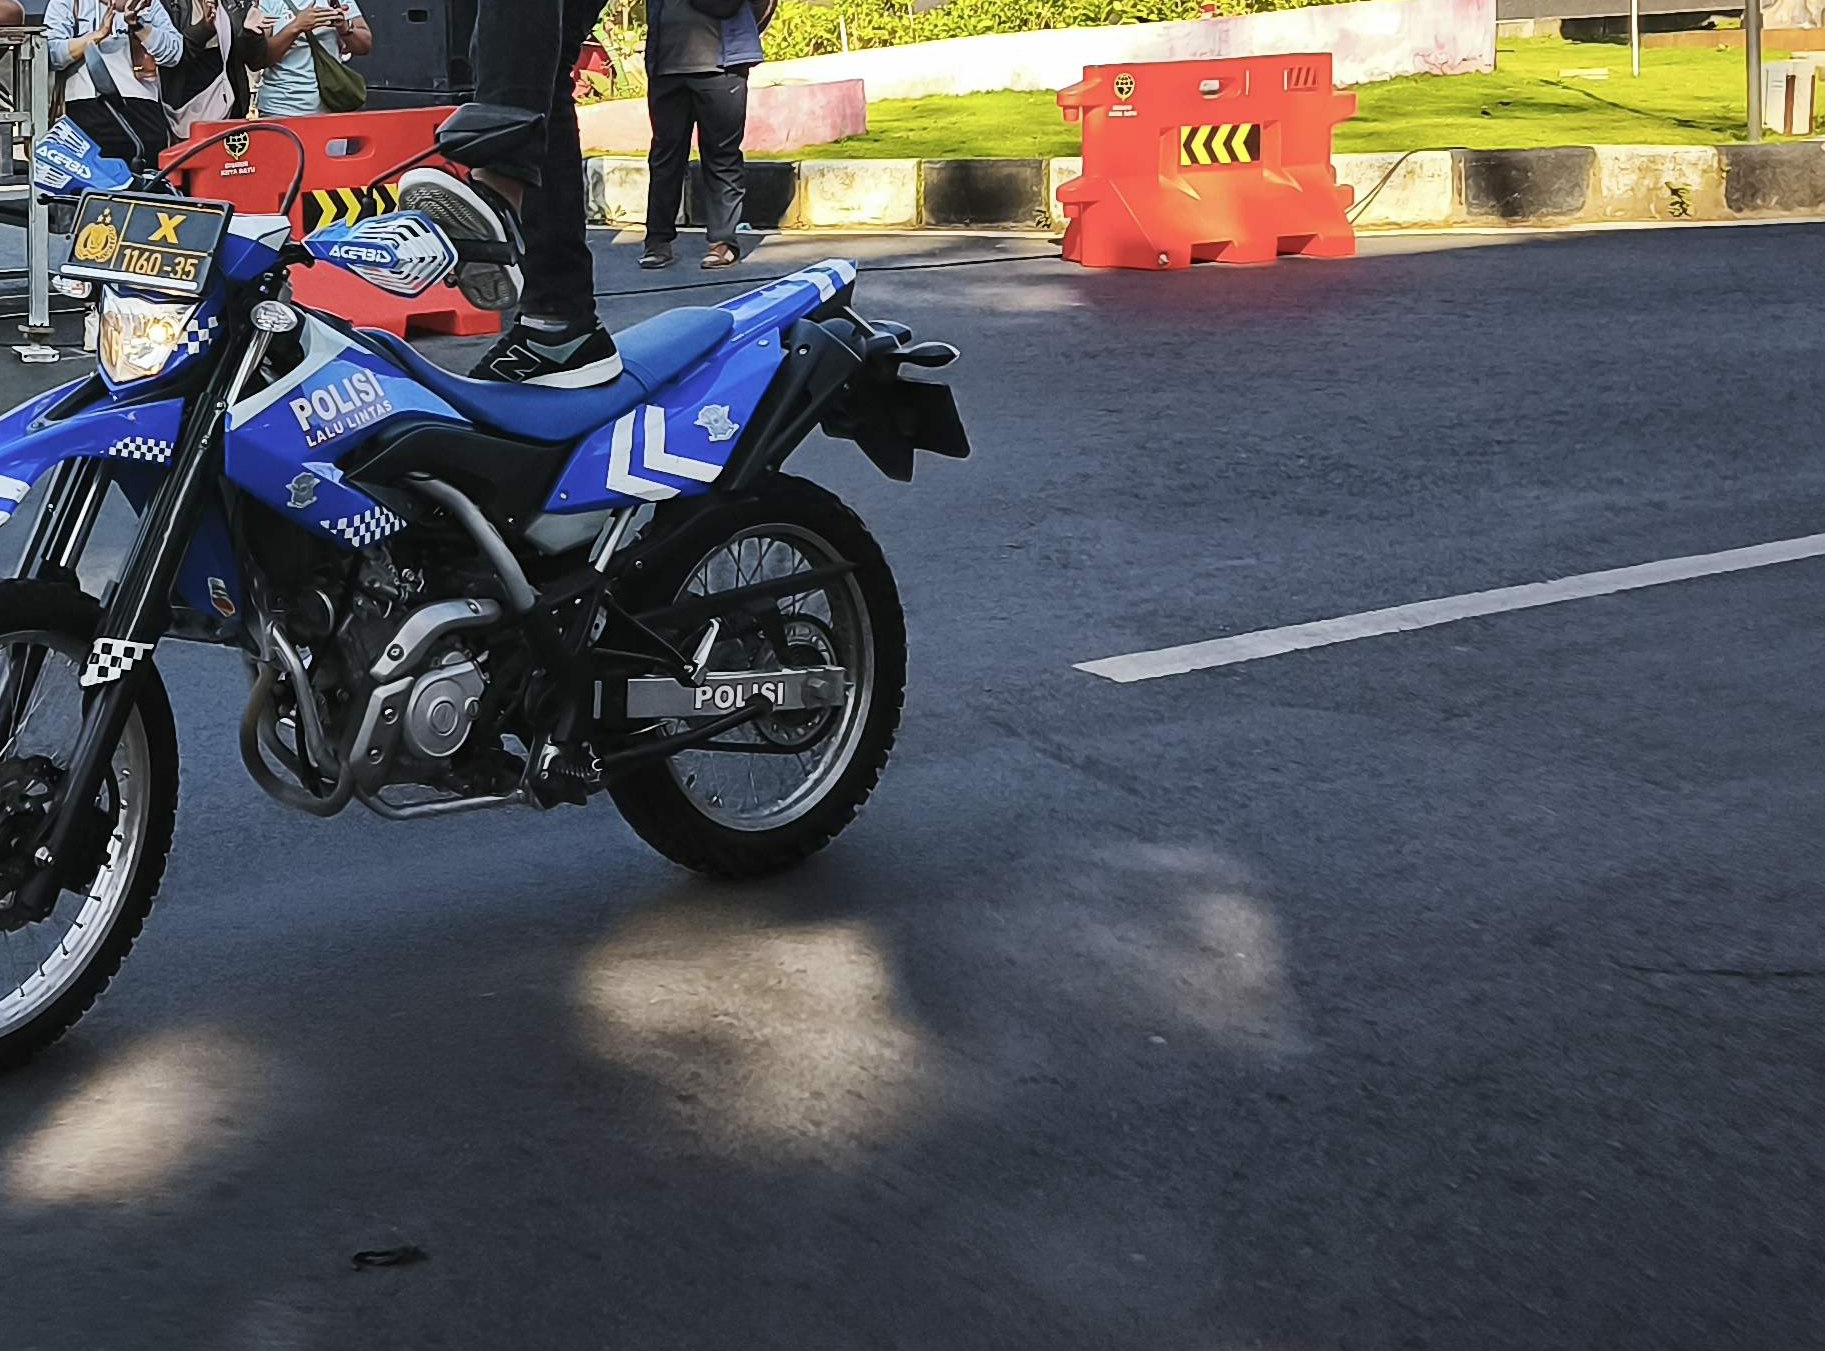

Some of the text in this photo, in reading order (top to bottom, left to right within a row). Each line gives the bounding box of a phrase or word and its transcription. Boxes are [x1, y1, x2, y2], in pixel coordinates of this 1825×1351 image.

[148, 212, 187, 244] X
[289, 368, 385, 432] POLISI
[305, 400, 393, 447] LALU LINTAS
